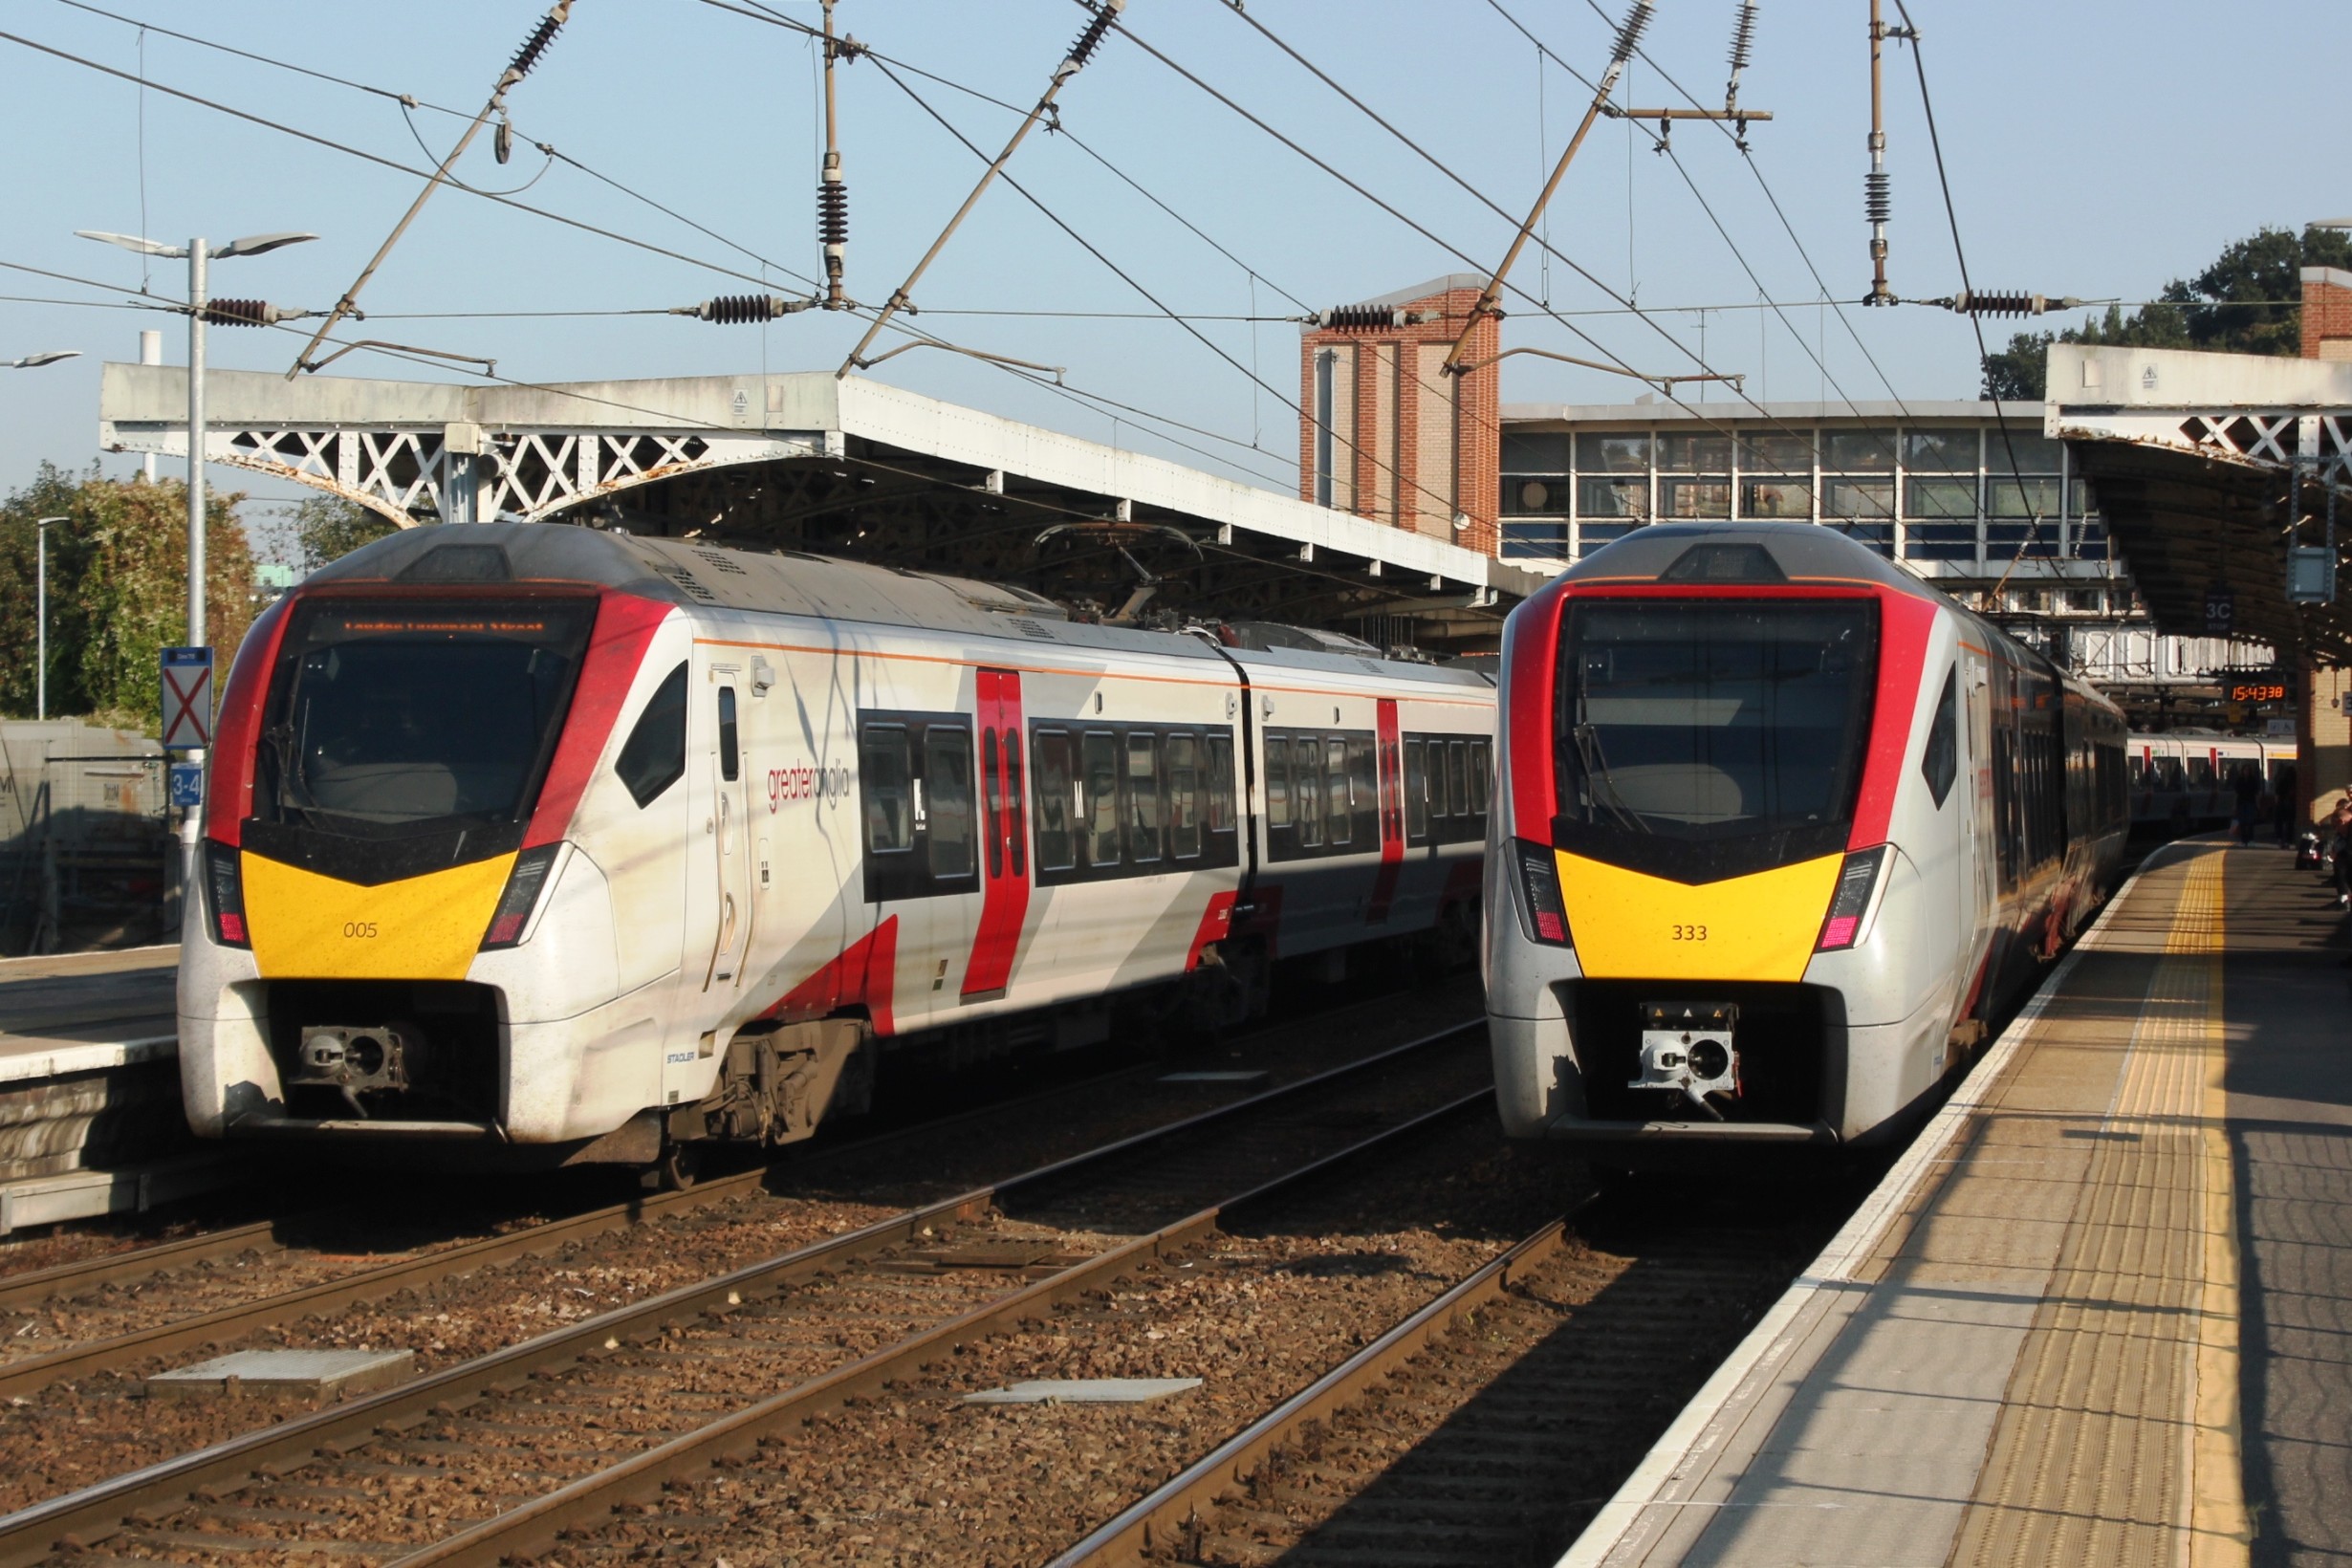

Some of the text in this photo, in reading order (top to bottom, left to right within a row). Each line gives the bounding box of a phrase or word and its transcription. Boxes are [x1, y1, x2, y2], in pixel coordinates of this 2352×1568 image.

[2206, 603, 2231, 619] 3C
[173, 774, 200, 795] 3-4
[344, 922, 378, 938] 005
[1672, 925, 1707, 941] 333
[667, 1052, 695, 1064] STADLER
